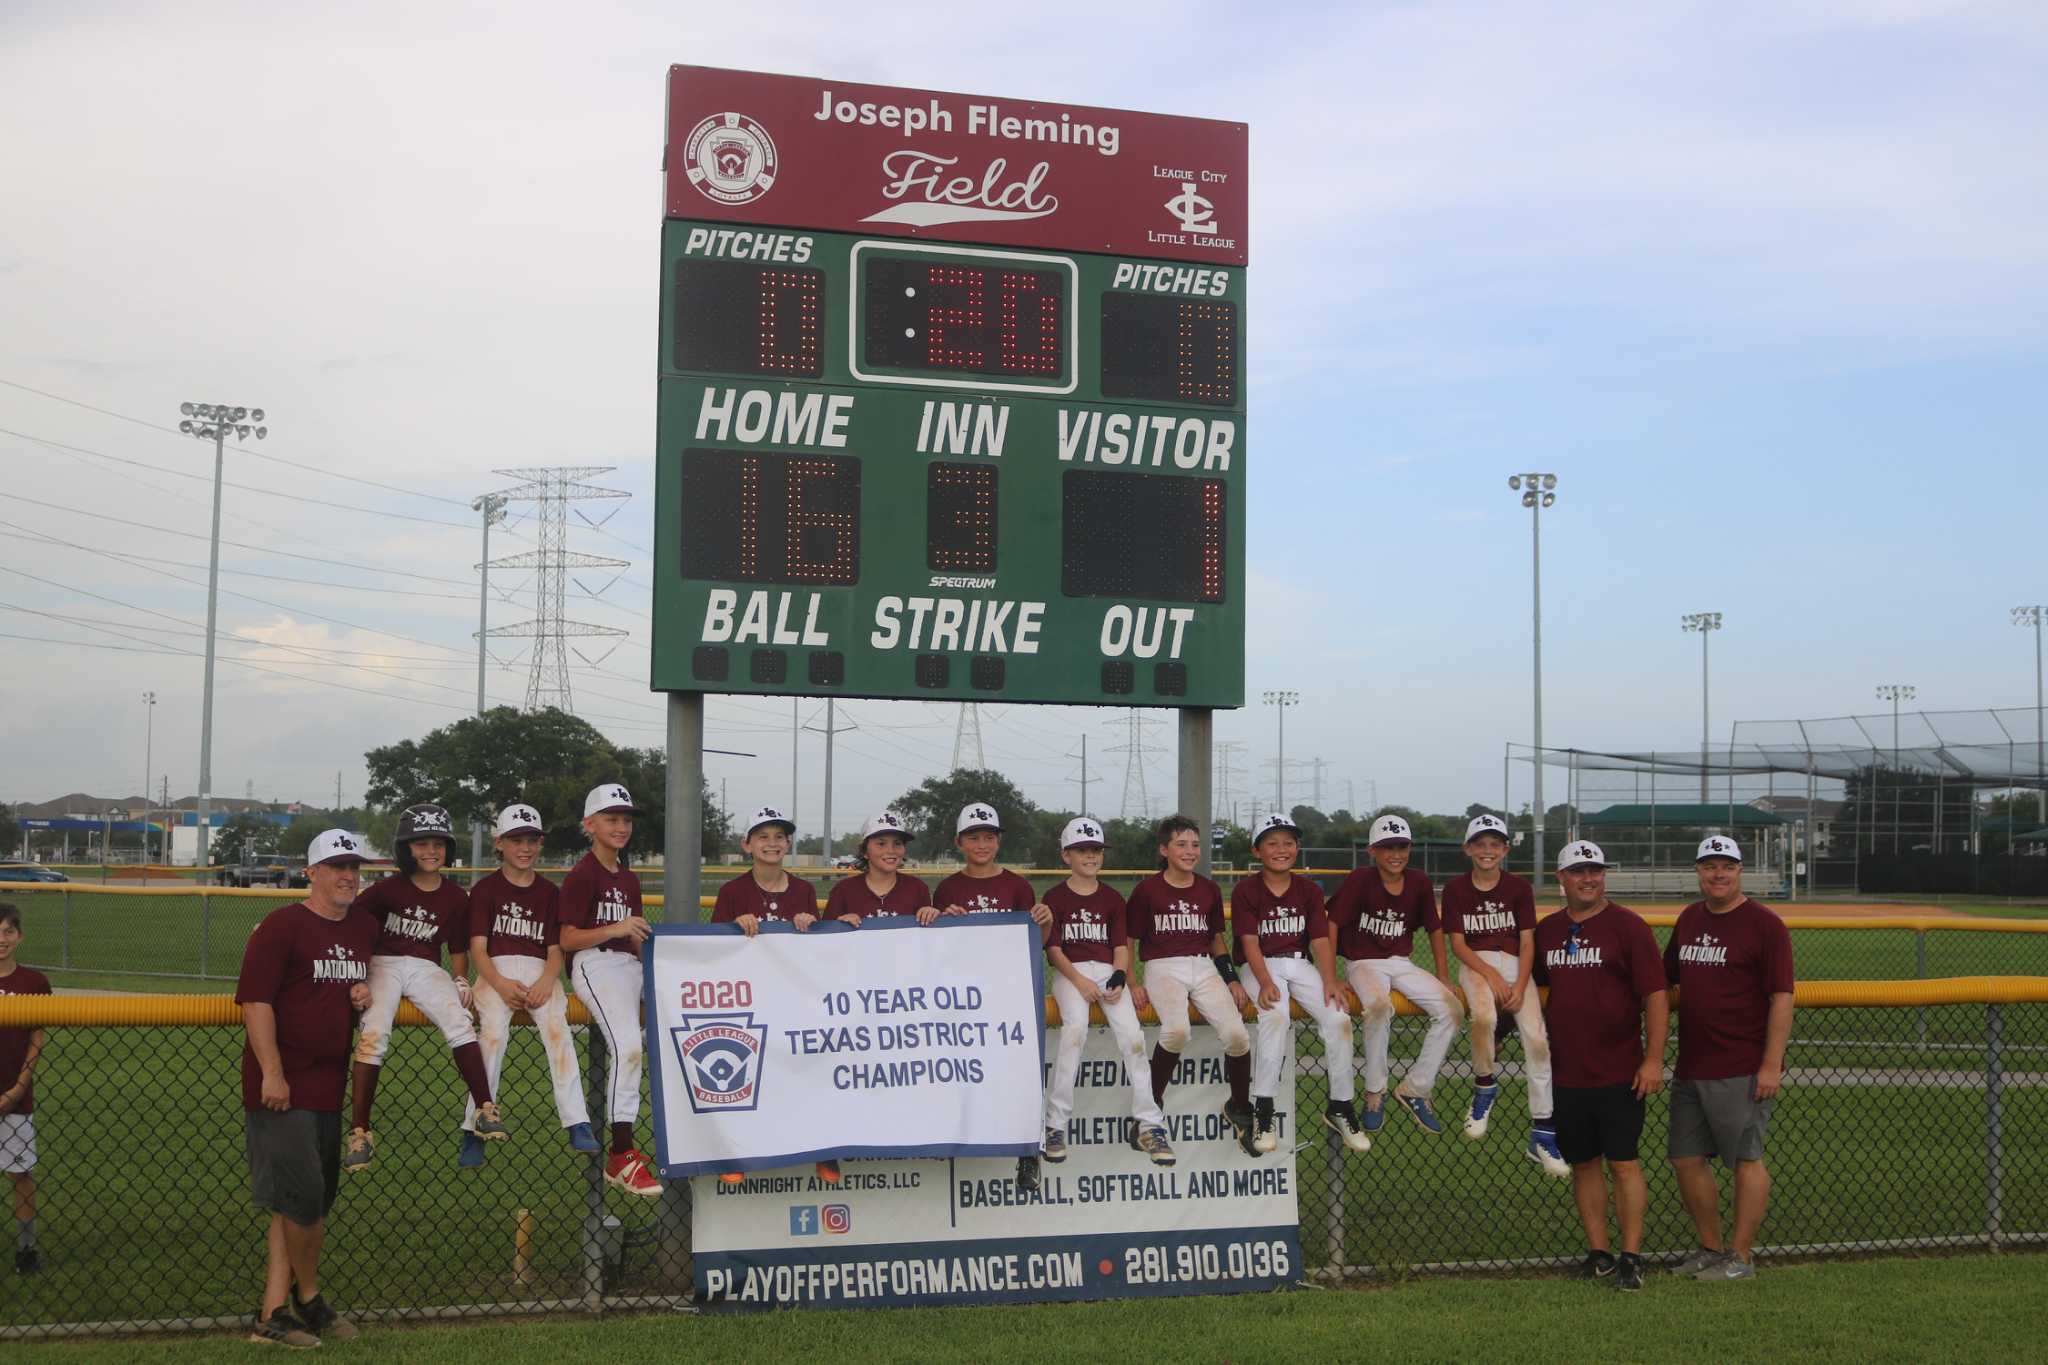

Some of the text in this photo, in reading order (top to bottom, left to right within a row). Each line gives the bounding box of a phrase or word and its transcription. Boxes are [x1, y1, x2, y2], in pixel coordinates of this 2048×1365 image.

[813, 91, 1121, 155] Joseph Fleming
[882, 150, 1058, 213] Field
[685, 228, 813, 263] PITCHES
[1113, 263, 1230, 297] PITCHES
[695, 387, 855, 448] HOME
[916, 400, 1010, 457] INN
[1058, 409, 1236, 471] VISITOR
[741, 457, 853, 580] 16
[1204, 483, 1219, 597] 1
[928, 576, 996, 589] SPECTRUM
[701, 589, 829, 646] BALL
[870, 596, 1046, 654] STRIKE
[1099, 605, 1194, 659] OUT
[493, 914, 545, 941] ATIONAL
[1463, 910, 1517, 932] NATIONA
[680, 980, 753, 1009] 2020
[822, 986, 982, 1016] 10 YEAR OLD
[785, 1021, 1024, 1055] TEXAS DISTRICT 14
[833, 1058, 985, 1090] CHAMPIONS
[698, 1089, 750, 1103] BASEBALL
[894, 1172, 921, 1188] LLC
[1078, 1173, 1182, 1203] SOFTBALL
[1187, 1170, 1229, 1199] AND
[1234, 1168, 1288, 1197] MORE
[706, 1240, 1289, 1302] PLAYOFFPERFORMANCE.COM 281.910.0136
